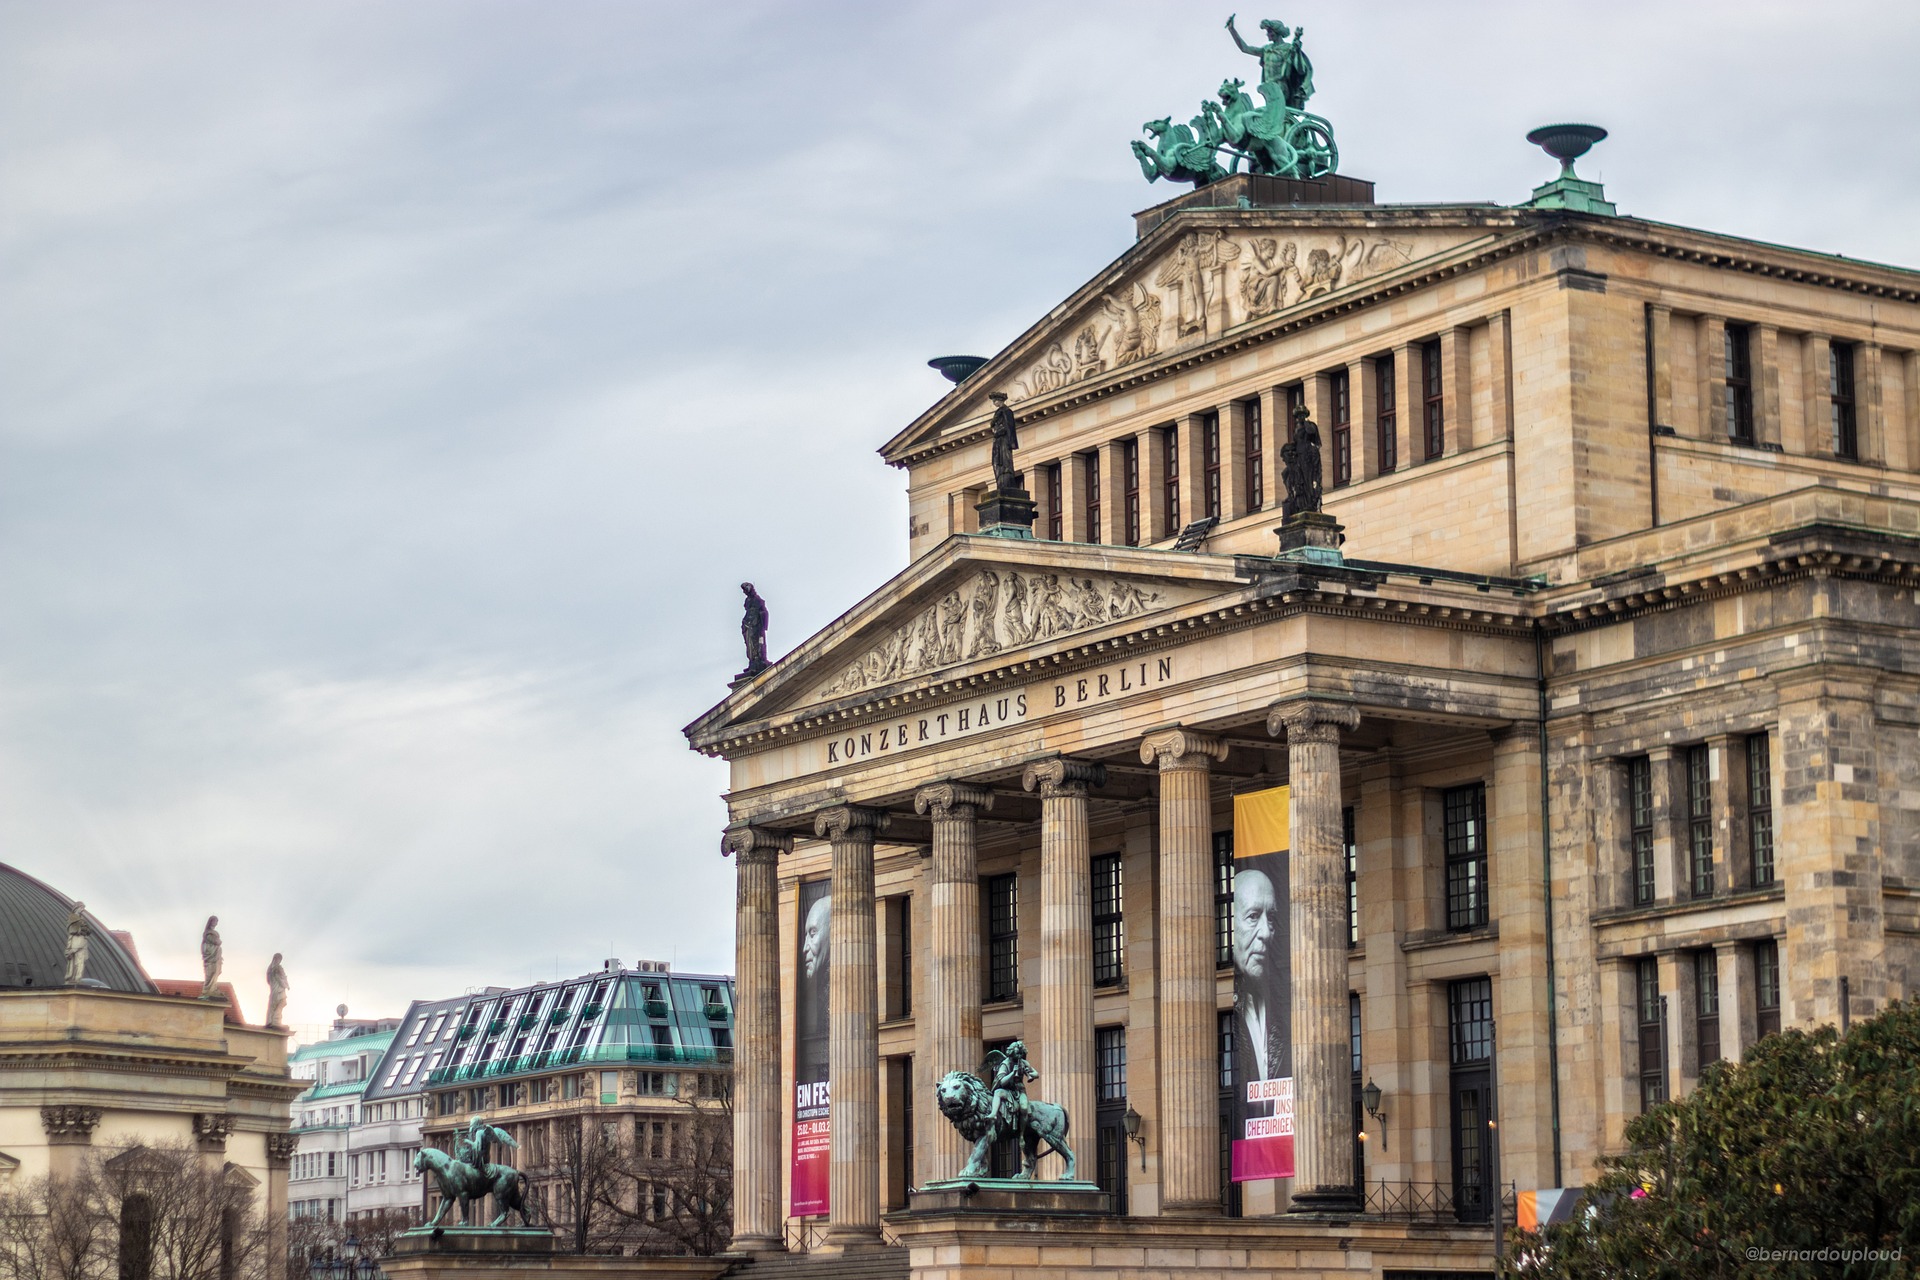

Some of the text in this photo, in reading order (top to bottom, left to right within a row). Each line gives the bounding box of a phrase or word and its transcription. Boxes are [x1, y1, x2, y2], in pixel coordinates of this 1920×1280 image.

[828, 657, 1172, 763] KONZERTHAUS BERLIN
[797, 1083, 811, 1108] EIN
[1249, 1083, 1261, 1099] 80.
